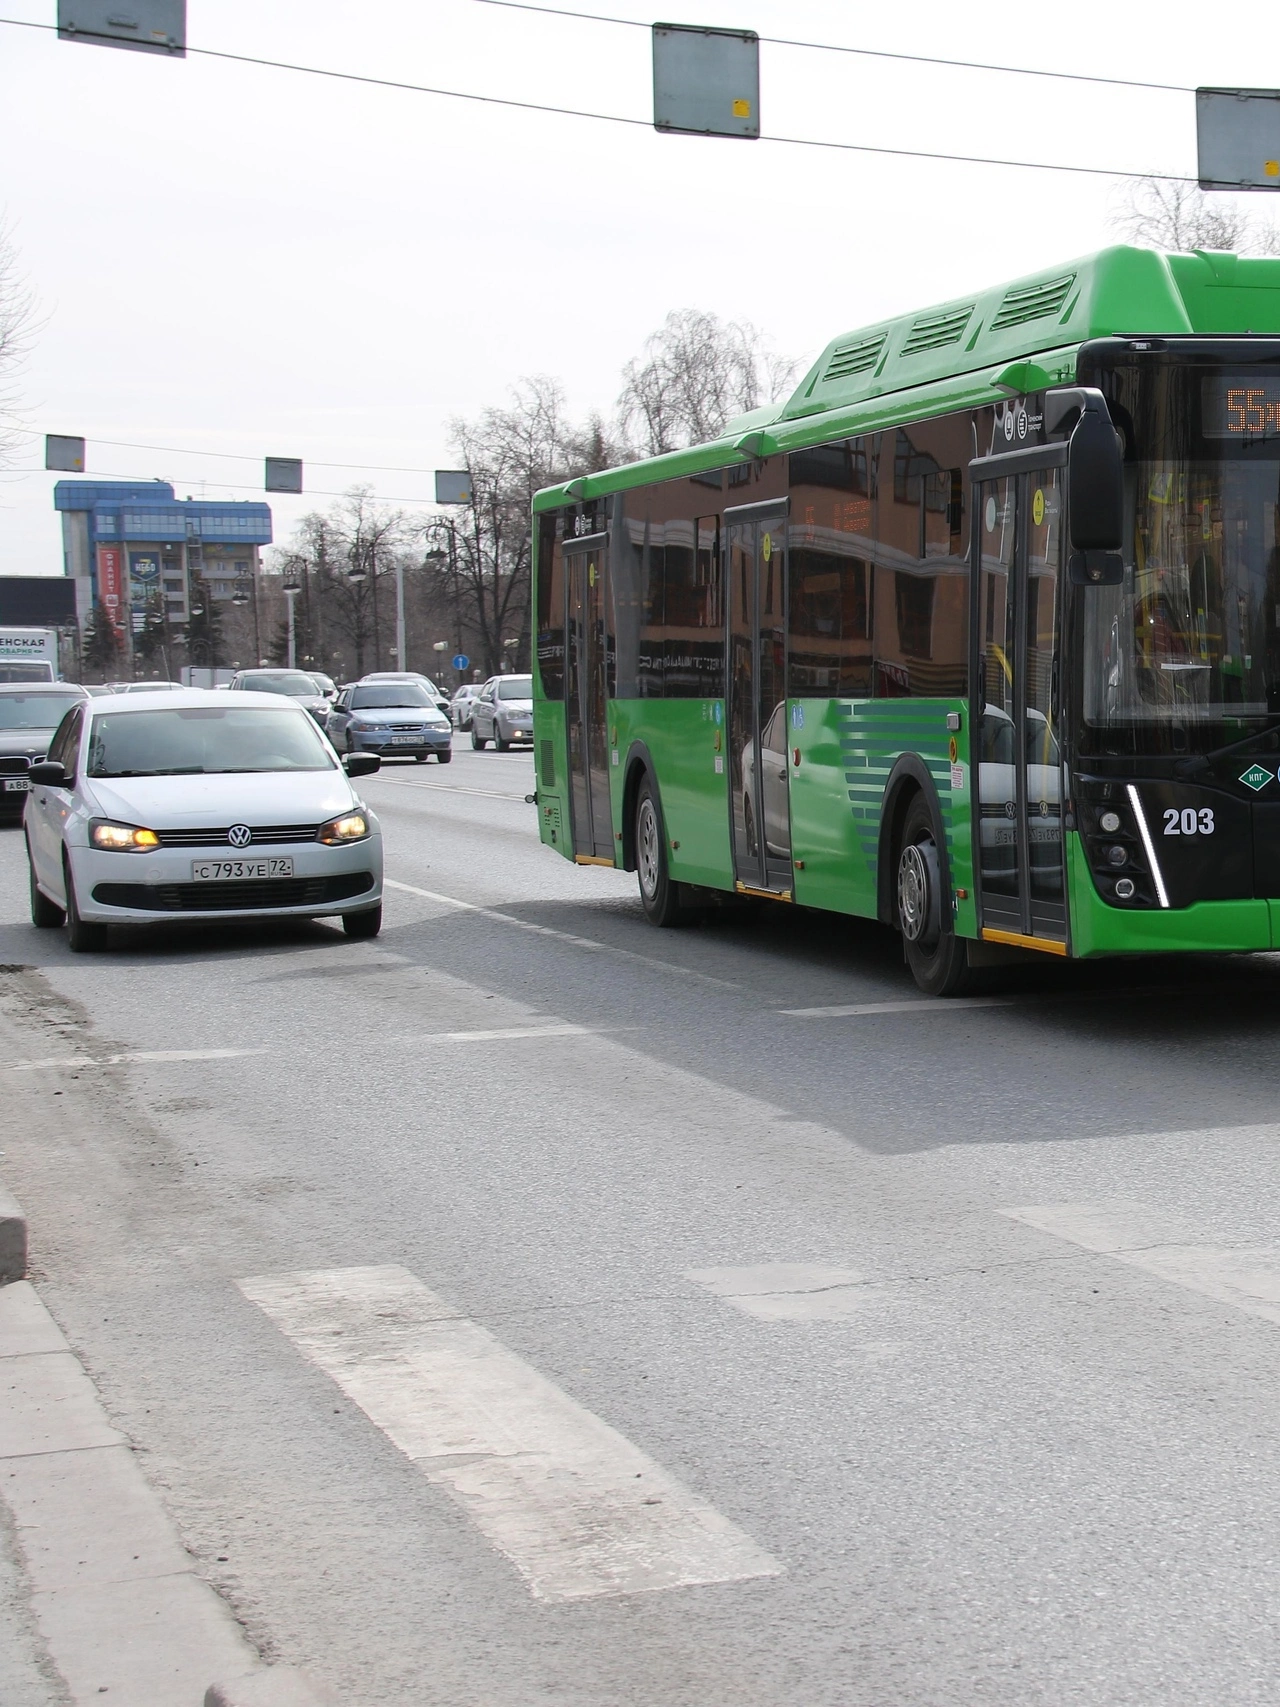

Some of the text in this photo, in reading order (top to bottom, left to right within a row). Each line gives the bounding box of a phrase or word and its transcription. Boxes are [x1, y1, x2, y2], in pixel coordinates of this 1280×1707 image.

[1249, 773, 1264, 782] КПГ
[9, 781, 31, 790] А88
[1163, 808, 1215, 835] 203
[270, 860, 286, 872] 72
